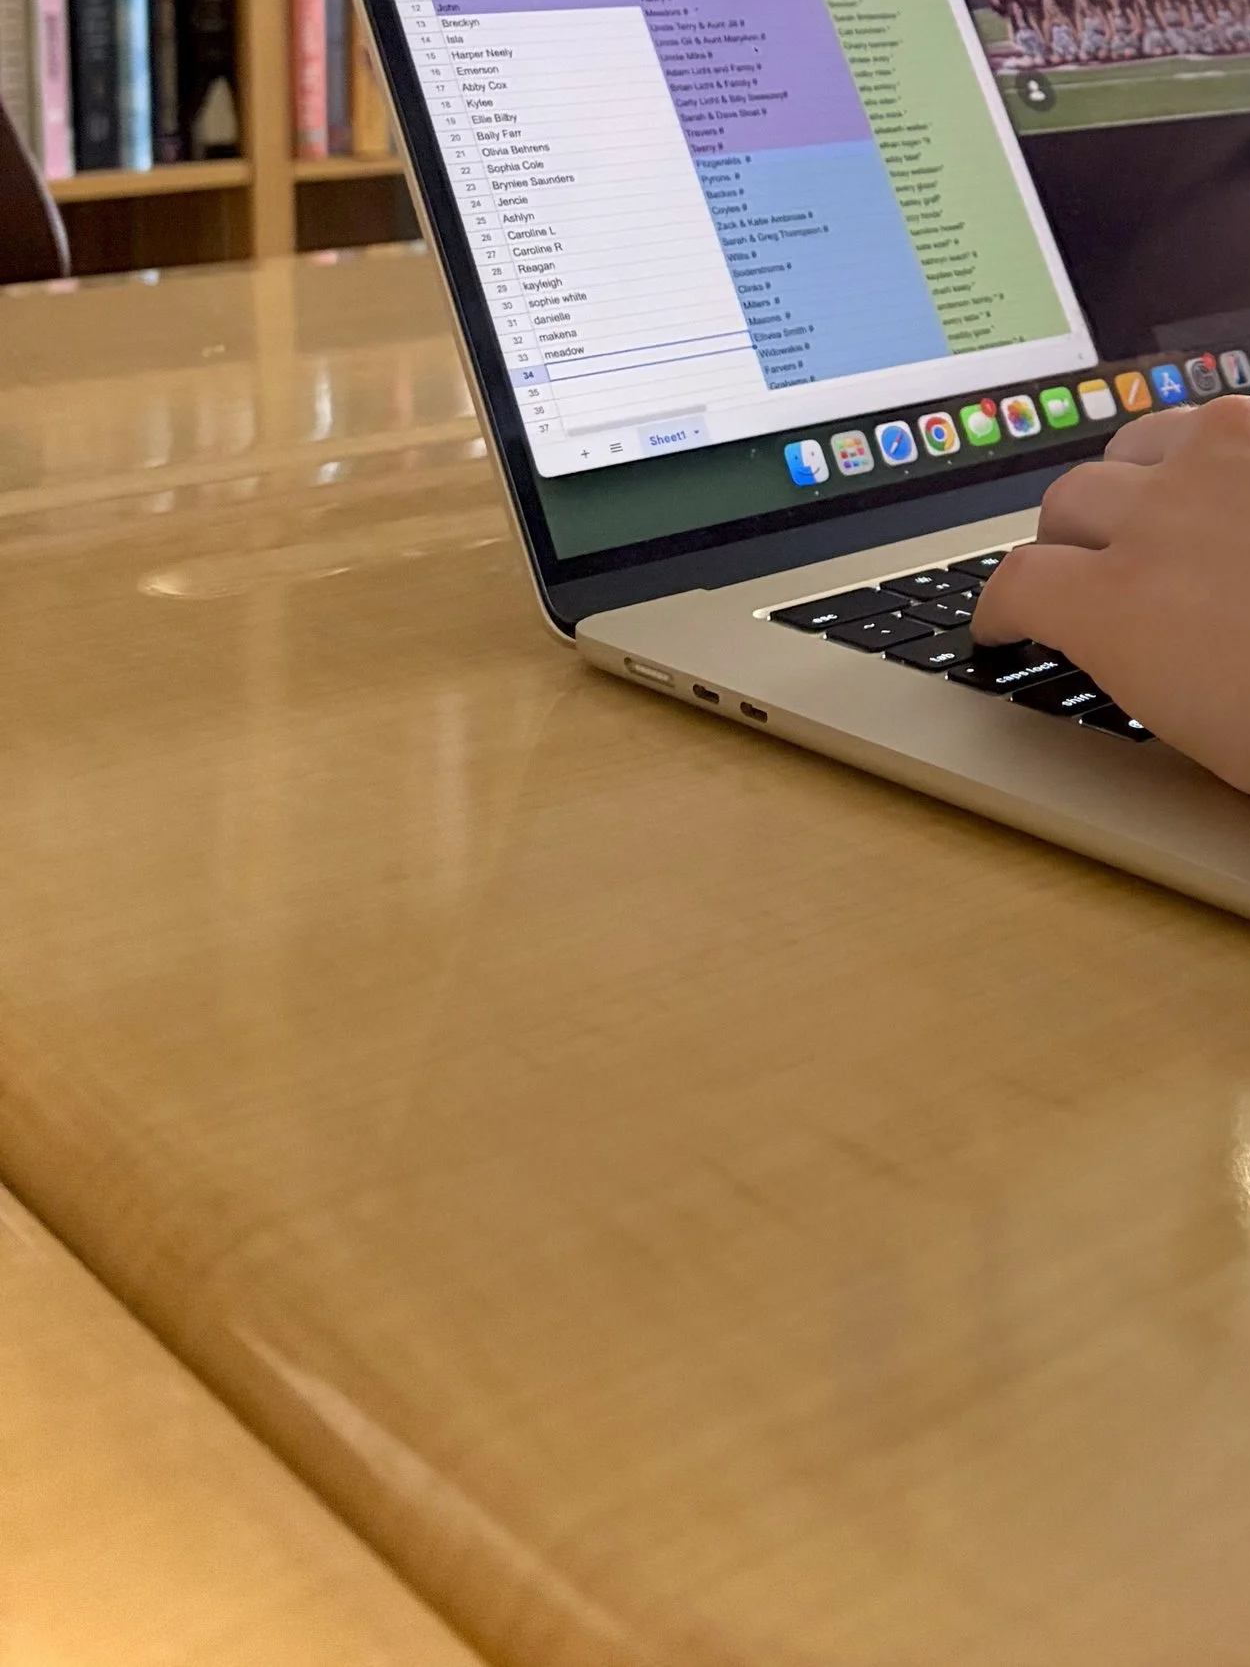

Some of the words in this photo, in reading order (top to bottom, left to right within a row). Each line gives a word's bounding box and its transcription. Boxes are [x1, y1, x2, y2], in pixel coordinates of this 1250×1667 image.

[436, 3, 461, 12] John
[445, 34, 464, 44] Isla
[450, 50, 484, 60] Harper
[485, 48, 513, 58] Neely
[455, 66, 499, 76] Emerson
[462, 82, 486, 93] Abby
[487, 80, 508, 90] Cox
[471, 114, 493, 125] Ellie
[501, 128, 522, 138] Farr
[481, 147, 509, 157] Olivia
[510, 144, 550, 155] Behrens
[486, 162, 521, 174] Sophia
[521, 160, 544, 170] Cole
[529, 174, 575, 186] Saunders
[502, 212, 535, 223] Ashlyn
[507, 228, 547, 240] Caroline
[548, 226, 556, 236] L
[512, 245, 553, 257] Caroline
[553, 241, 563, 252] R
[517, 262, 556, 274] Reagan
[522, 277, 563, 292] kayleigh
[528, 296, 560, 308] sophie
[561, 292, 587, 303] white
[533, 312, 571, 325] danielle
[538, 329, 577, 342] makena
[544, 346, 584, 359] meadow
[650, 431, 687, 447] Sheet1
[812, 614, 838, 624] esc
[929, 652, 955, 663] tab
[995, 668, 1029, 684] caps
[1028, 661, 1058, 674] lock
[1061, 691, 1096, 707] shift
